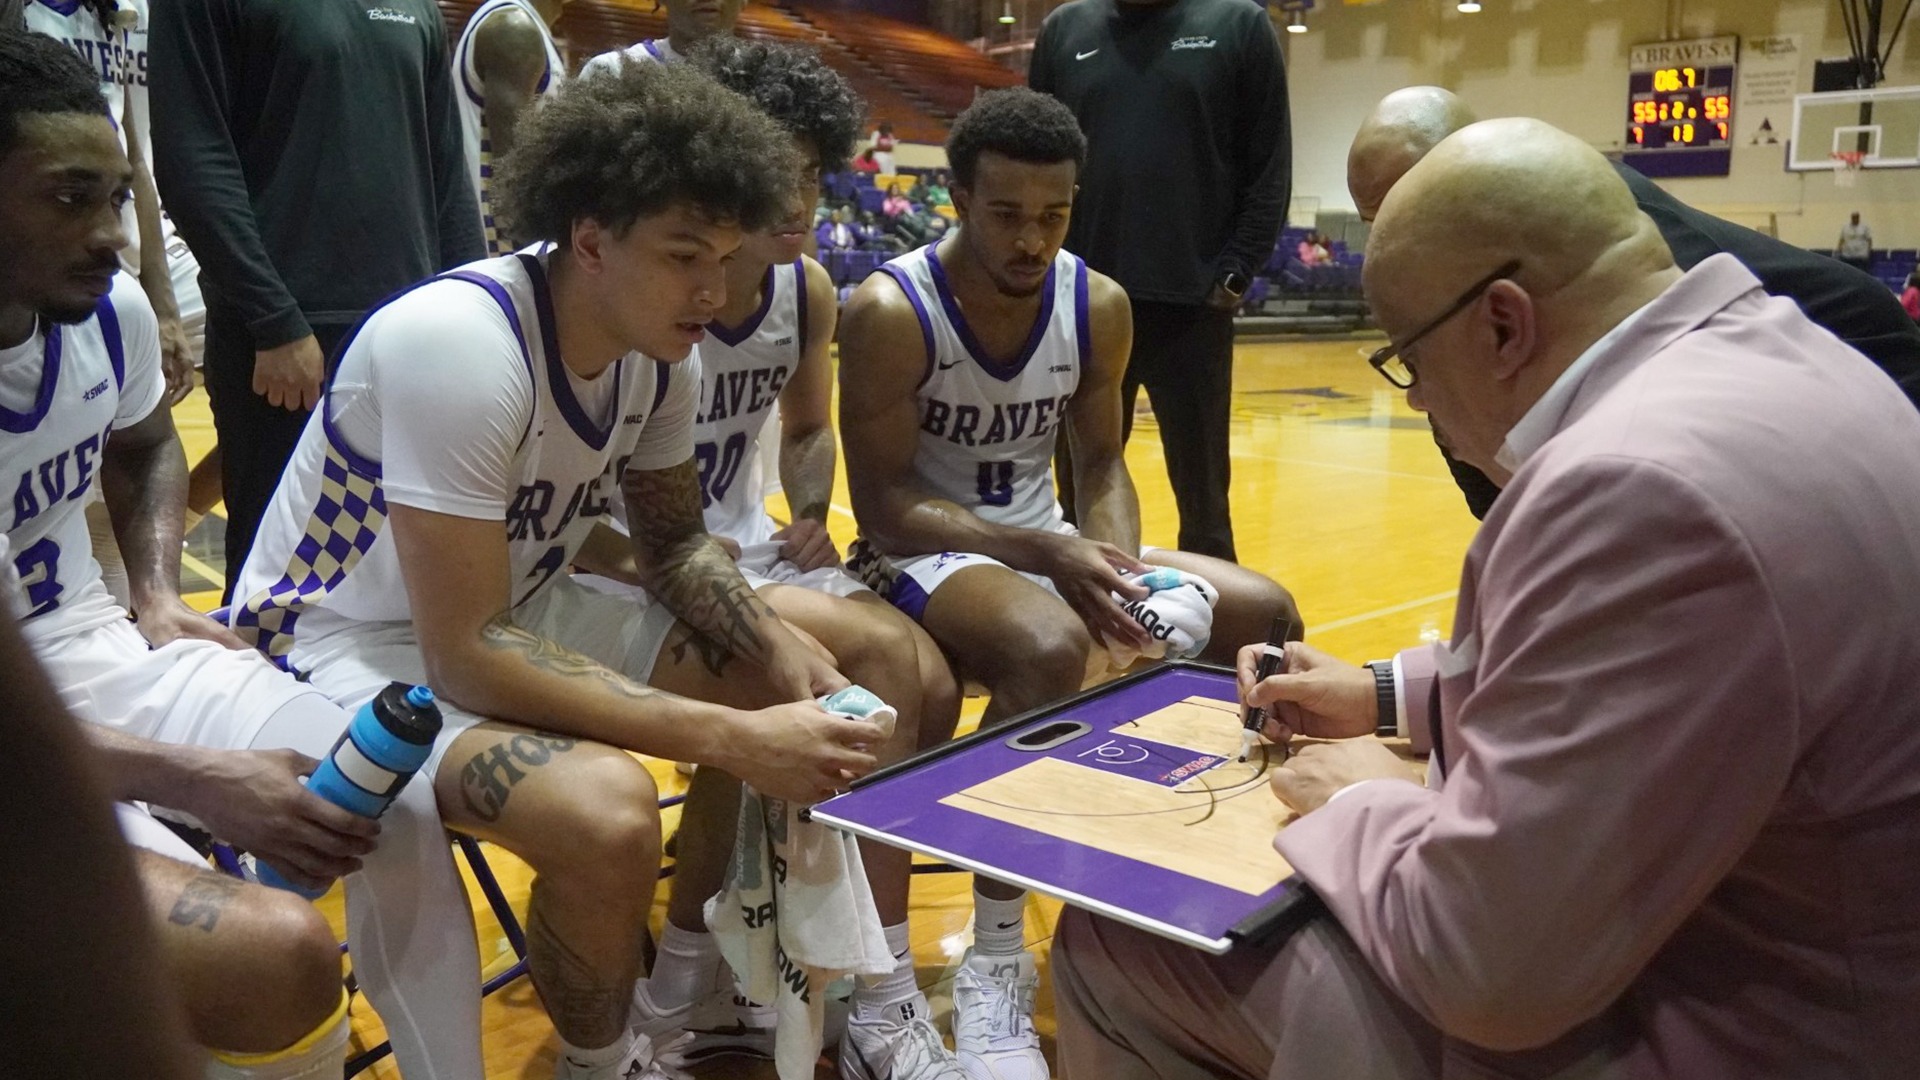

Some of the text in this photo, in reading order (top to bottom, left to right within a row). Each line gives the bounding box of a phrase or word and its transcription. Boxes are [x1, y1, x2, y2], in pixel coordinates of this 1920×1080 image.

[1633, 101, 1657, 123] 55
[1704, 96, 1729, 119] 55
[90, 378, 109, 400] SWAC
